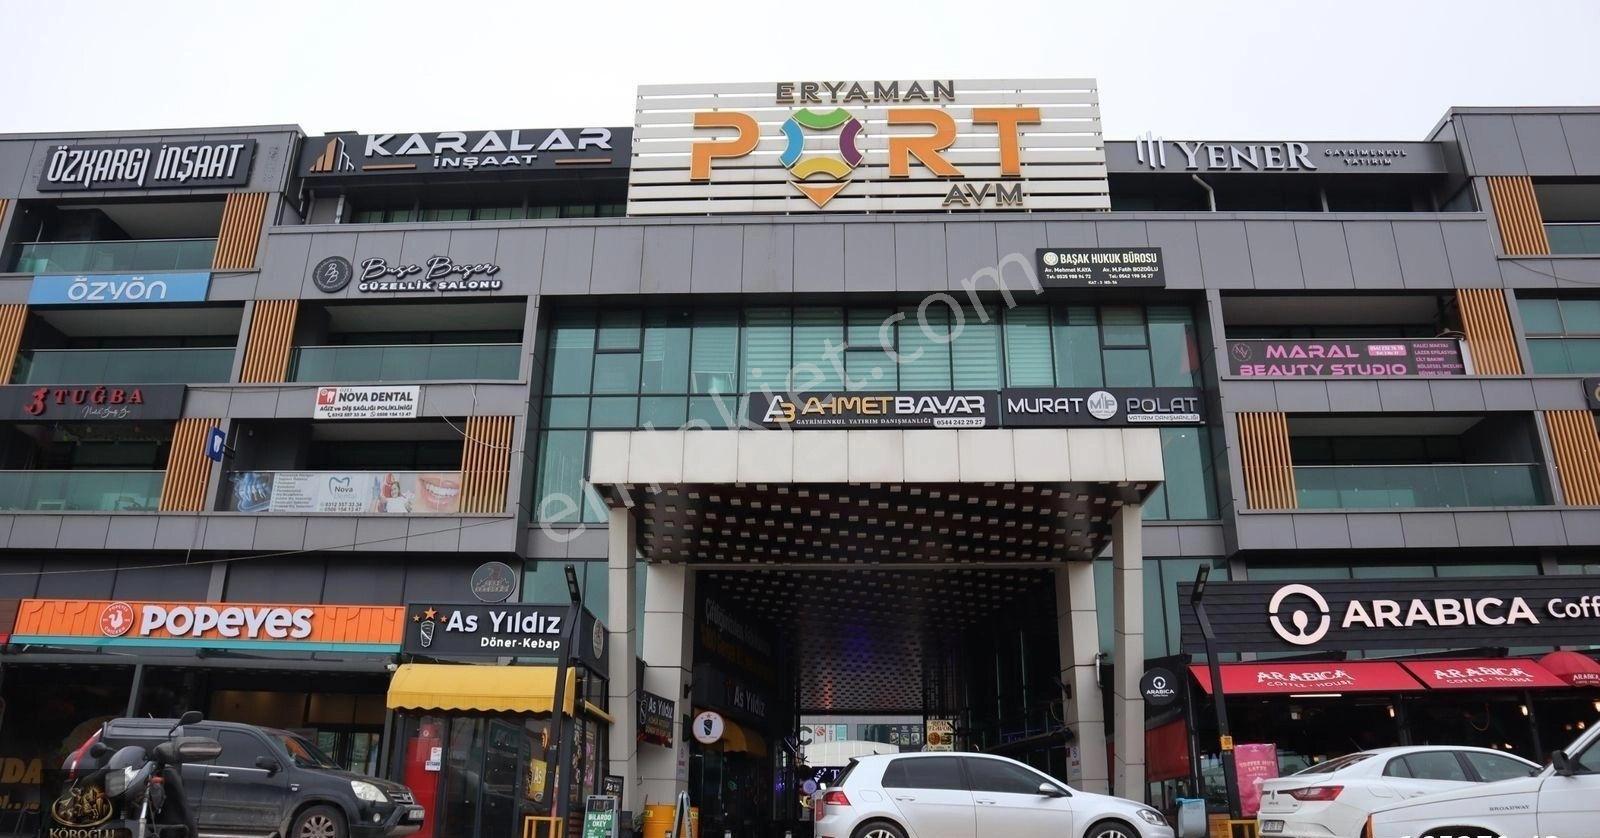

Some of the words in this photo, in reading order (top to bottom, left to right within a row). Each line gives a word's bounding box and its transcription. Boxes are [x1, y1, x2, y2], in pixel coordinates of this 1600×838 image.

[776, 80, 955, 104] ERYAMAN
[364, 128, 612, 157] KARALAR
[690, 107, 1041, 180] PORT
[433, 154, 537, 168] İNŞAAT
[1173, 142, 1317, 172] YENER
[1344, 158, 1392, 166] YATIRIM
[47, 145, 150, 188] ÖZKARGI
[154, 144, 244, 182] İNŞAAT
[942, 183, 1023, 207] AVM
[1060, 253, 1090, 265] BAŞAK
[1091, 253, 1121, 264] HUKUK
[1123, 251, 1157, 263] BÜROSU
[359, 279, 433, 291] GÜZELLİK
[438, 280, 501, 290] SALONU
[1266, 344, 1360, 359] MARAL
[1240, 364, 1323, 376] BEAUTY
[1331, 363, 1407, 376] STUDIO
[54, 386, 144, 405] TUĞBA
[338, 392, 368, 402] NOVA
[370, 391, 413, 402] DENTAL
[1008, 397, 1084, 413] MURAT
[1126, 397, 1198, 413] POLAT
[880, 417, 931, 425] DANIŞMANLIĞI
[1342, 597, 1540, 628] ARABICA
[446, 610, 478, 632] As
[489, 611, 561, 634] Yıldız
[480, 637, 560, 651] Döner-Kebap
[1257, 668, 1355, 682] ARABICA
[1434, 667, 1533, 680] ARABICA
[1489, 804, 1530, 812] BROADWAY
